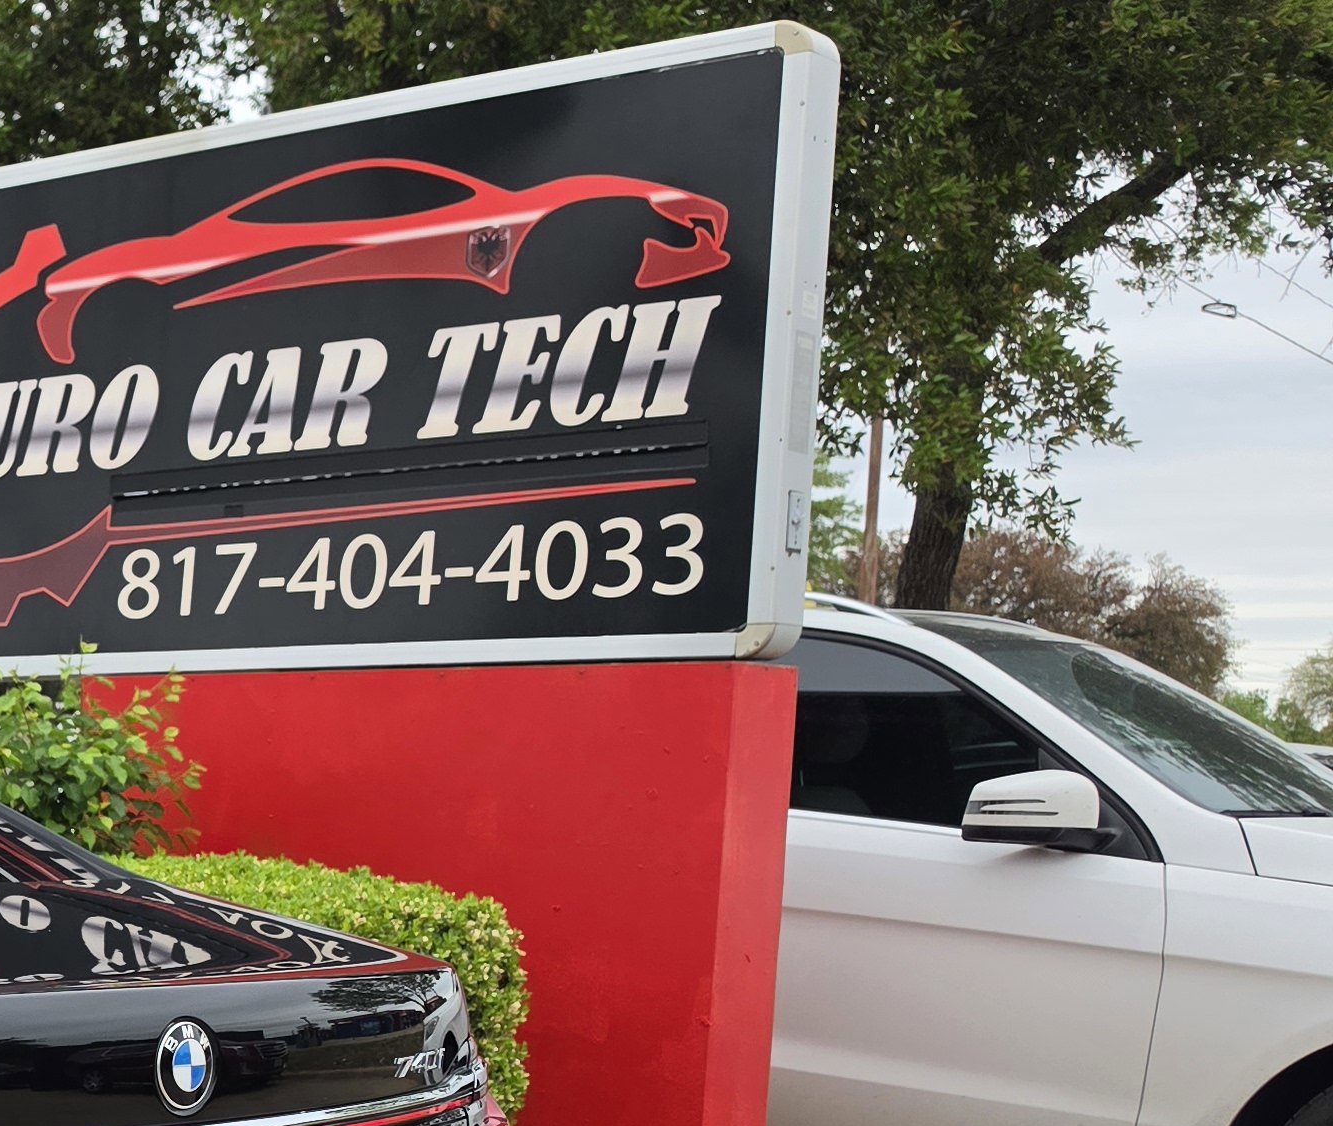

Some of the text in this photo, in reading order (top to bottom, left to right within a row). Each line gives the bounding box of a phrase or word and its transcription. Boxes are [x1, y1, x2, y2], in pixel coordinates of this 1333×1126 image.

[188, 338, 395, 461] CAR
[417, 295, 721, 440] TECH
[118, 513, 704, 620] 817-404-4033
[165, 1025, 210, 1053] BMW
